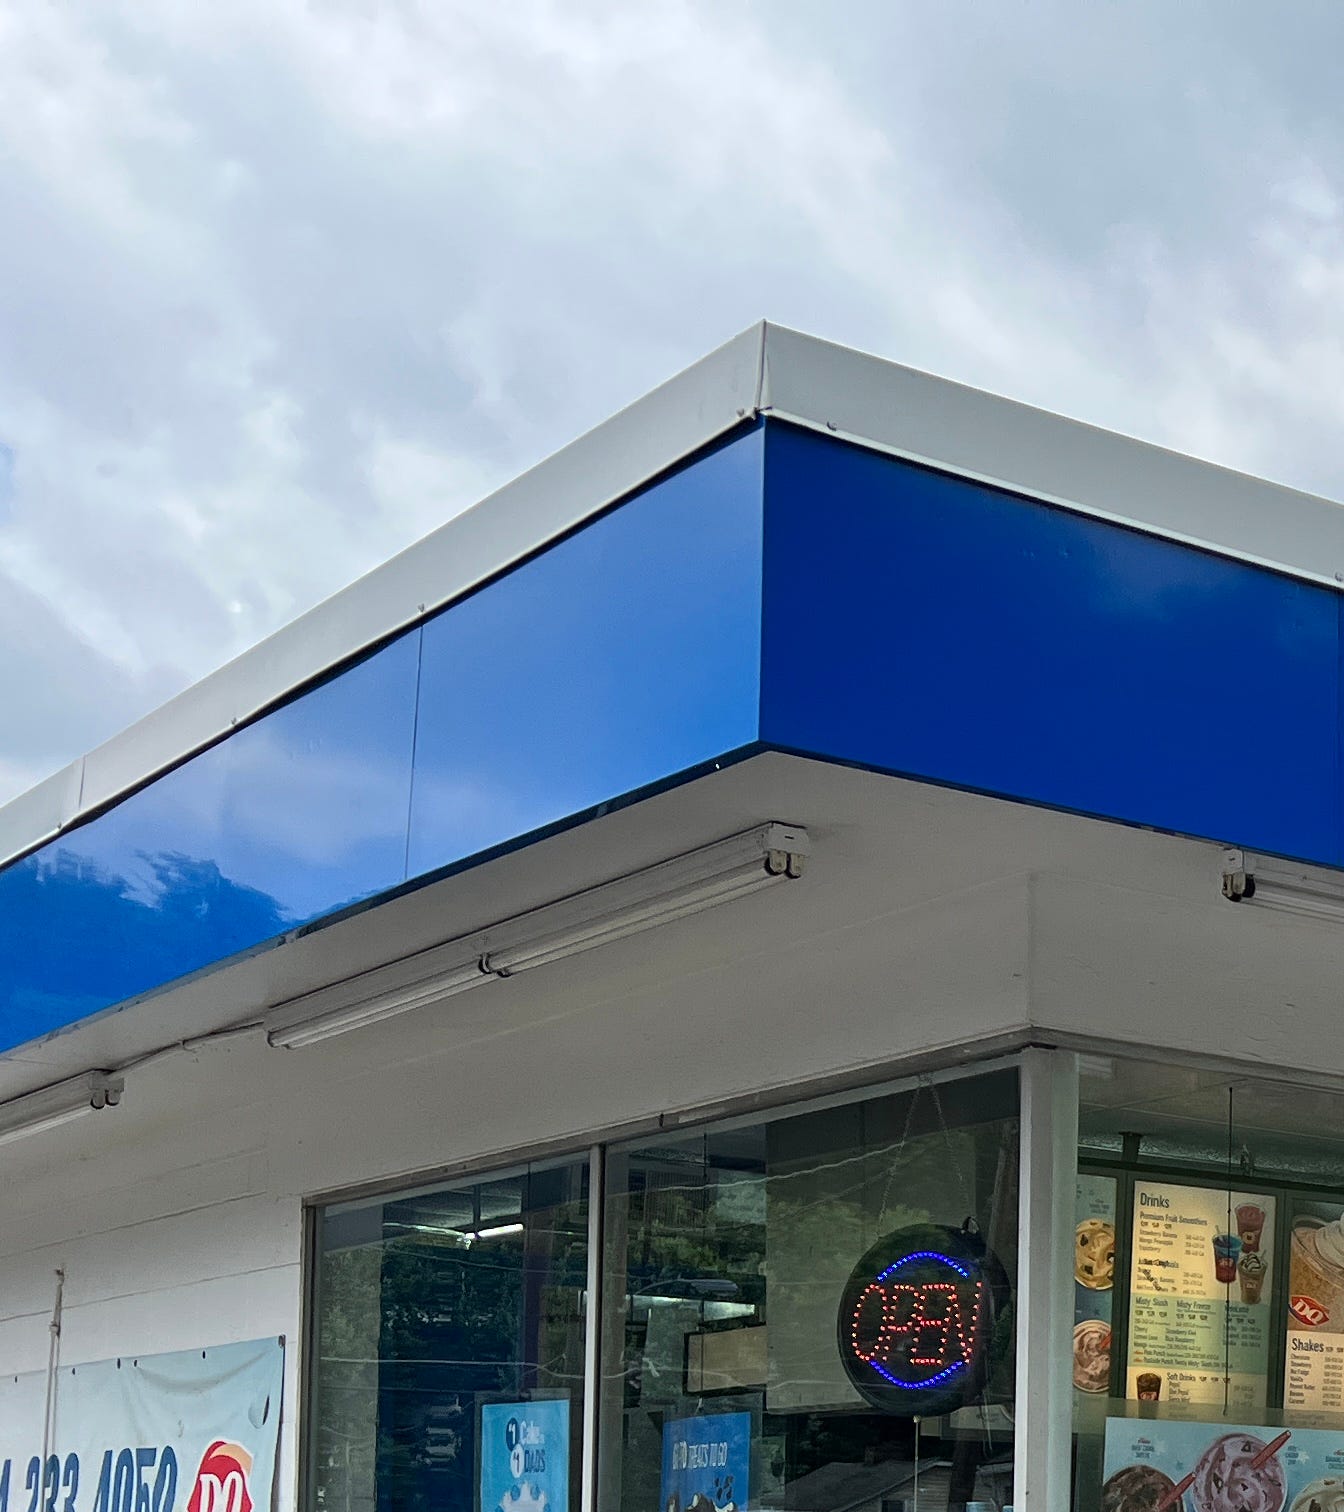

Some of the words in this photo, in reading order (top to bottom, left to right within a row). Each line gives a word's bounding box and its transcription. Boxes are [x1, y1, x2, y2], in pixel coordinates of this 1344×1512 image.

[1139, 1192, 1170, 1209] Drinks
[1293, 1299, 1325, 1326] DQ
[1291, 1337, 1325, 1353] Shakes
